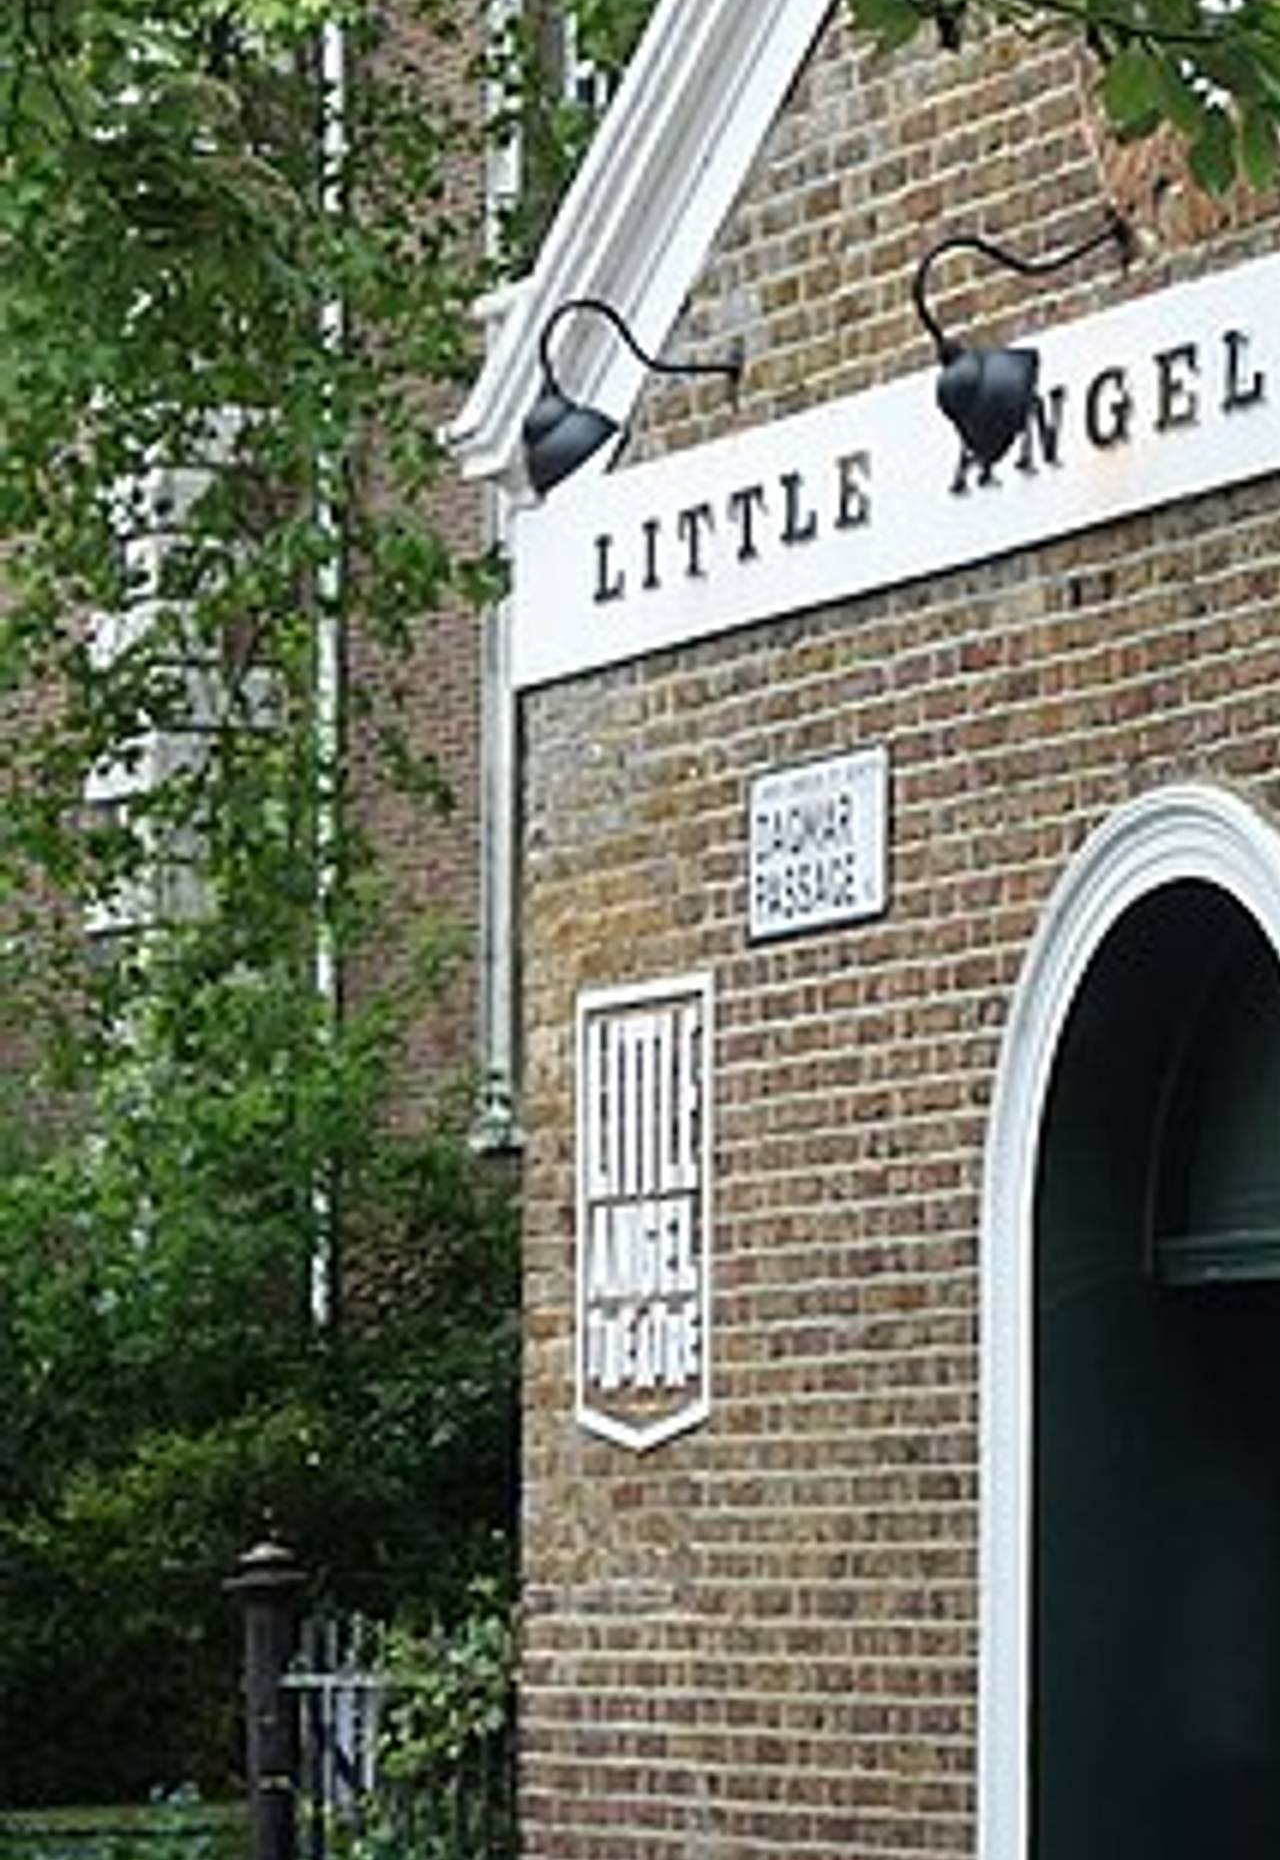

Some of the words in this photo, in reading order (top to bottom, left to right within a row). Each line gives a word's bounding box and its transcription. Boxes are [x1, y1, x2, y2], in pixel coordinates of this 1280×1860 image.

[594, 452, 873, 602] LITTLE
[755, 792, 854, 852] DAGMAR
[755, 851, 857, 924] PASSAGE
